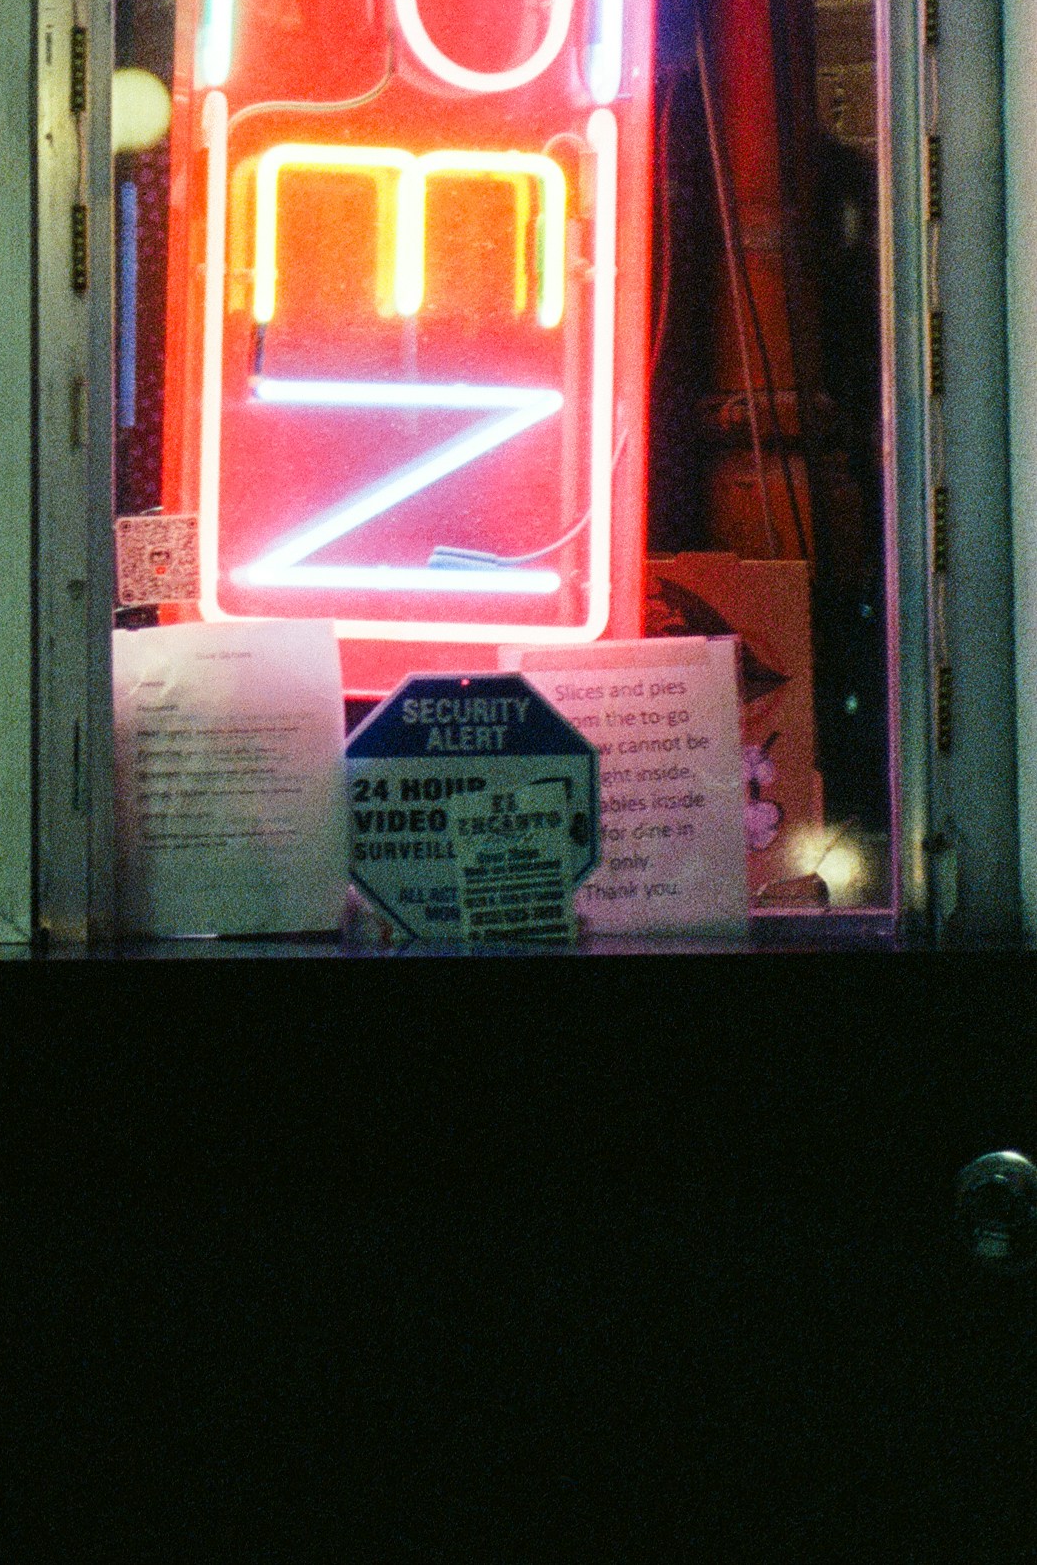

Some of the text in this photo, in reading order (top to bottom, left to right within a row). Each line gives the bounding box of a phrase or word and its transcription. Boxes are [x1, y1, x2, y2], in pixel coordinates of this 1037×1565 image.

[555, 680, 687, 701] Slices and pies
[402, 697, 530, 726] SECURITY
[571, 715, 599, 728] om
[606, 710, 638, 727] the
[426, 724, 508, 751] ALERT
[618, 738, 681, 756] cannot
[687, 733, 711, 751] be
[353, 779, 389, 803] 24
[601, 791, 705, 812] ables inside
[353, 808, 448, 834] VIDEO
[353, 840, 456, 861] SURVEILL
[586, 881, 638, 901] Thank
